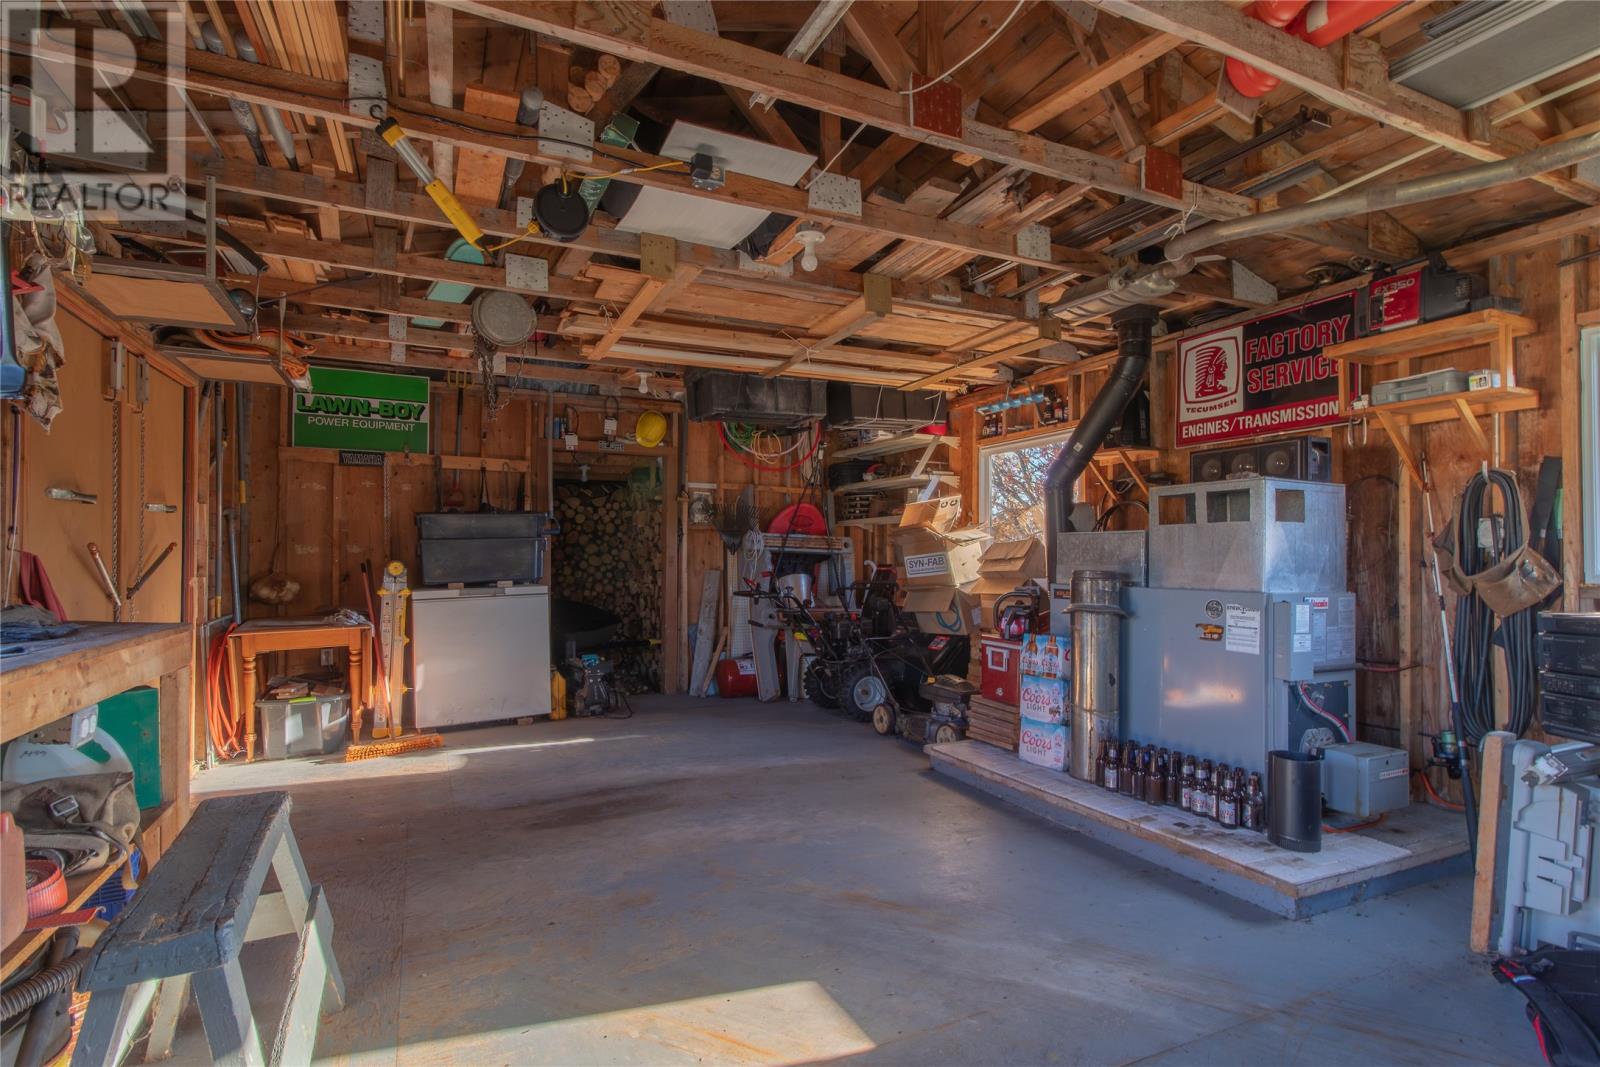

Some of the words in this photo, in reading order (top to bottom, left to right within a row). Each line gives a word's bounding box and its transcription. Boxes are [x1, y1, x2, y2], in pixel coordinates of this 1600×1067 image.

[1245, 314, 1351, 365] FACTORY
[1247, 353, 1340, 394] SERVICE
[296, 394, 425, 420] LAWN-BOY
[1186, 398, 1238, 414] TECUMSEH
[308, 416, 349, 427] POWER
[352, 419, 415, 432] EQUIPMENT
[908, 556, 945, 569] SYN-FAB
[1022, 687, 1051, 706] Coors
[1026, 703, 1047, 713] LIGHT
[1022, 730, 1052, 751] Coors
[1026, 745, 1047, 757] LIGHT
